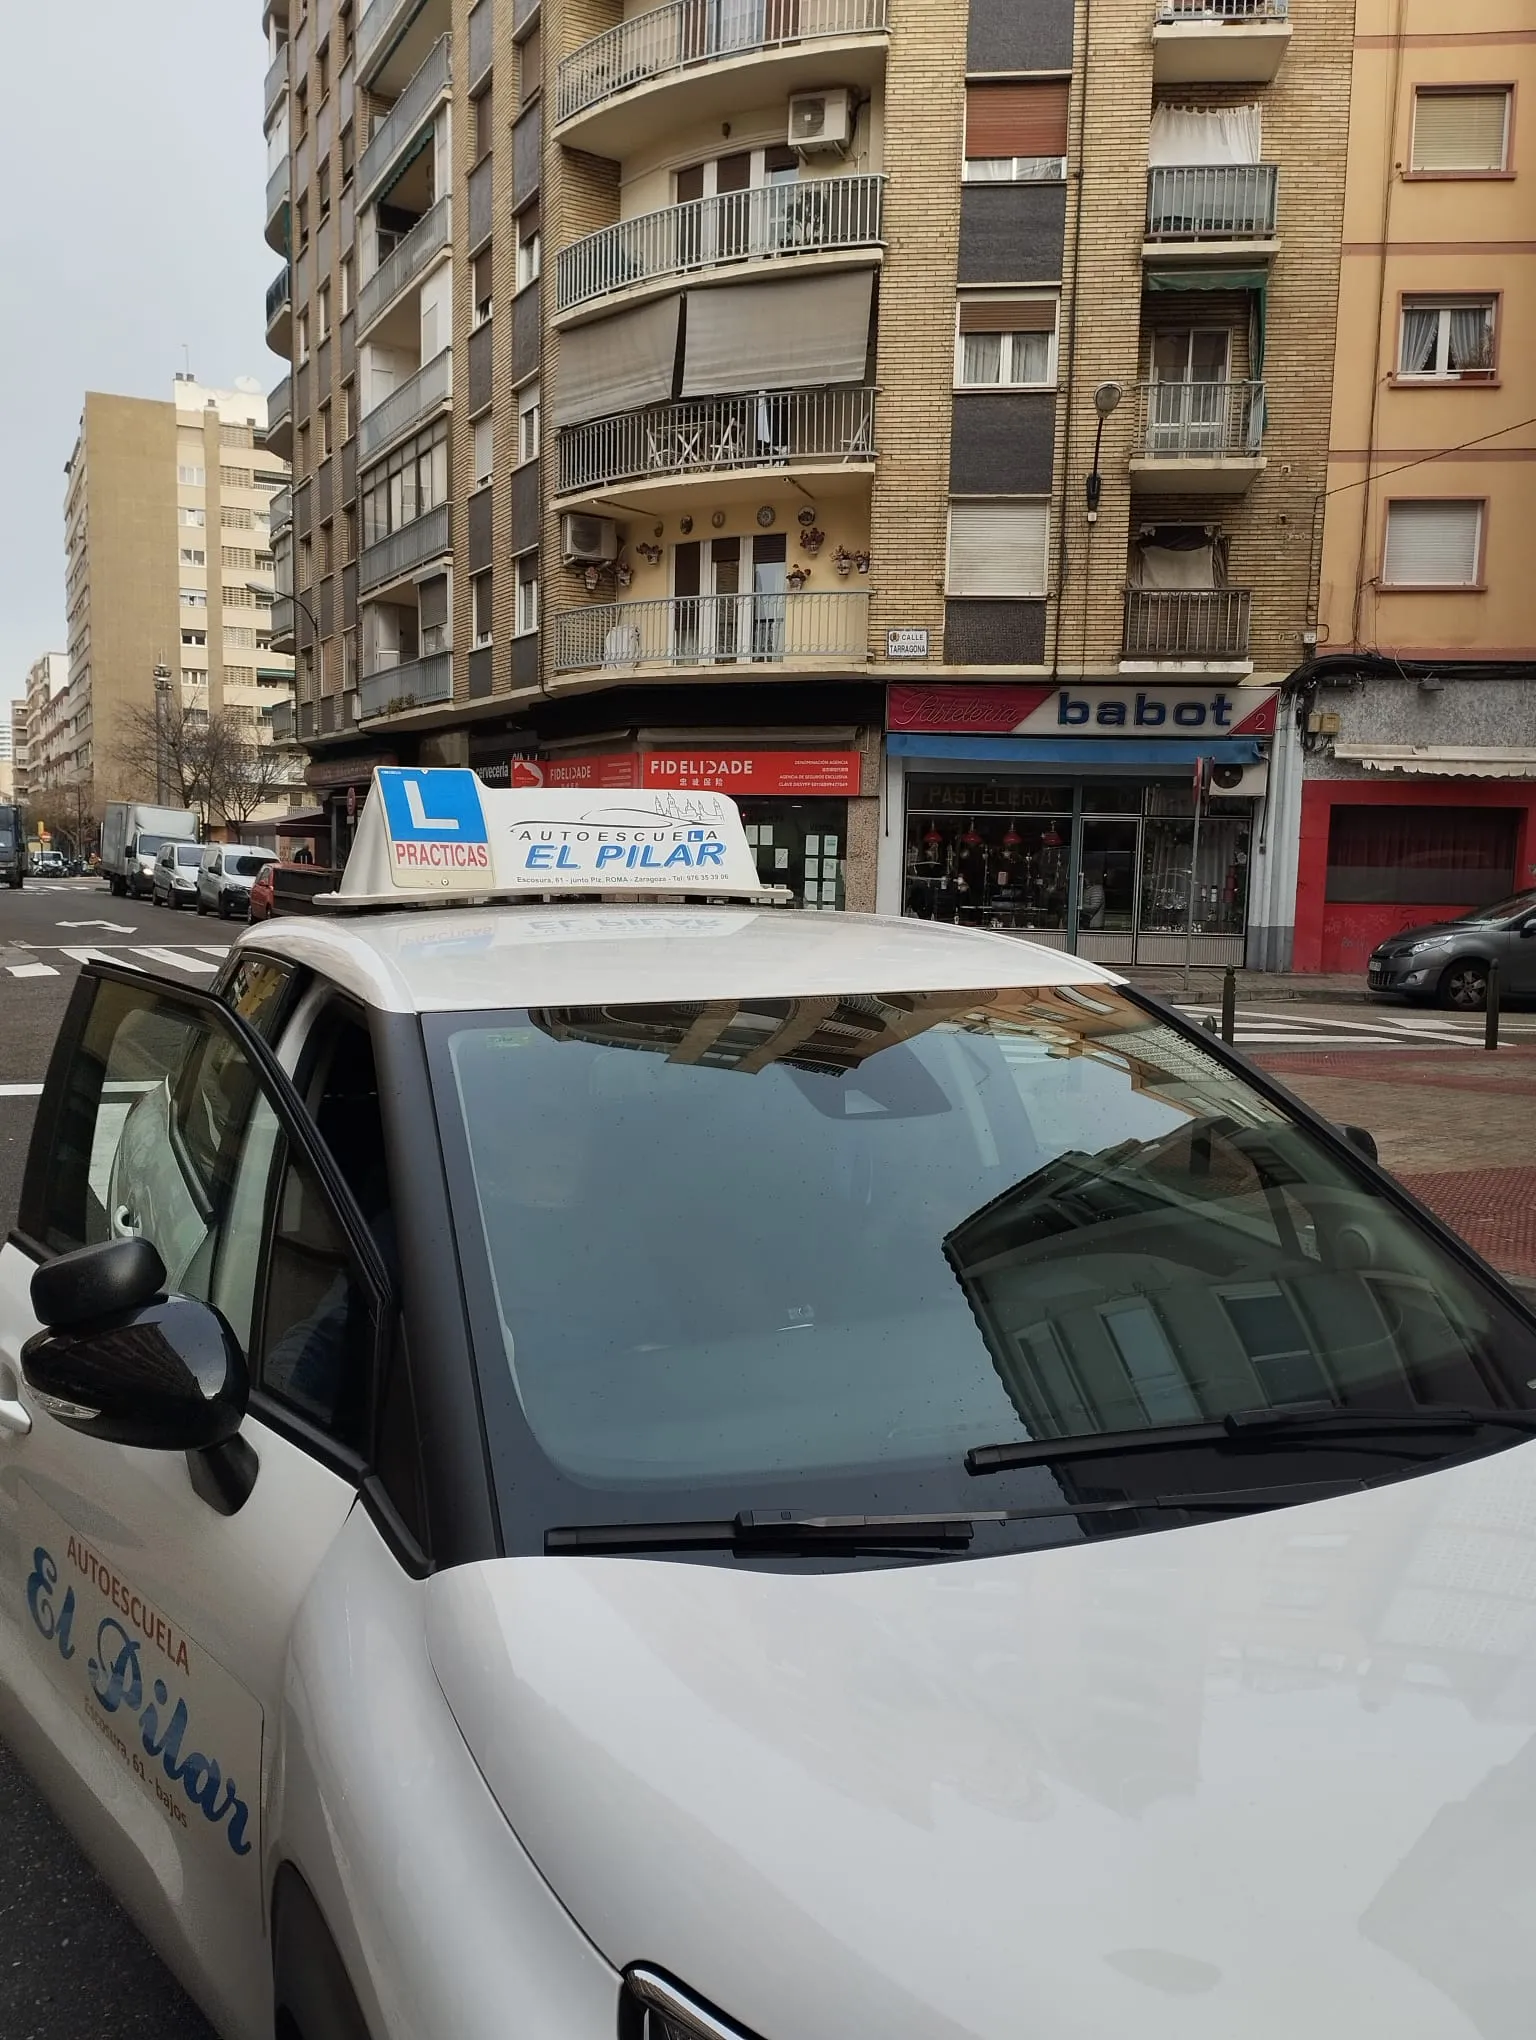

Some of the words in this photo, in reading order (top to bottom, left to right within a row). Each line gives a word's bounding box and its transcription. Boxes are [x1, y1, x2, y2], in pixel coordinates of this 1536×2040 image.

[890, 644, 926, 653] TARRAGONA
[1057, 692, 1233, 726] babot
[1254, 713, 1266, 730] 2
[550, 765, 592, 782] FIDELIDADE
[650, 760, 753, 775] FIDELIDADE
[402, 780, 460, 830] L
[519, 830, 718, 842] AUTOESCUELA
[395, 843, 488, 867] PRACTICAS
[524, 844, 581, 870] EL
[595, 842, 727, 869] PILAR
[516, 876, 554, 884] Escosura,
[634, 876, 667, 884] Zaragoza
[66, 1536, 190, 1676] AUTOESCUELA
[27, 1547, 75, 1660] El
[88, 1618, 251, 1855] Pilar
[132, 1753, 146, 1781] 61
[155, 1778, 187, 1828] bajos
